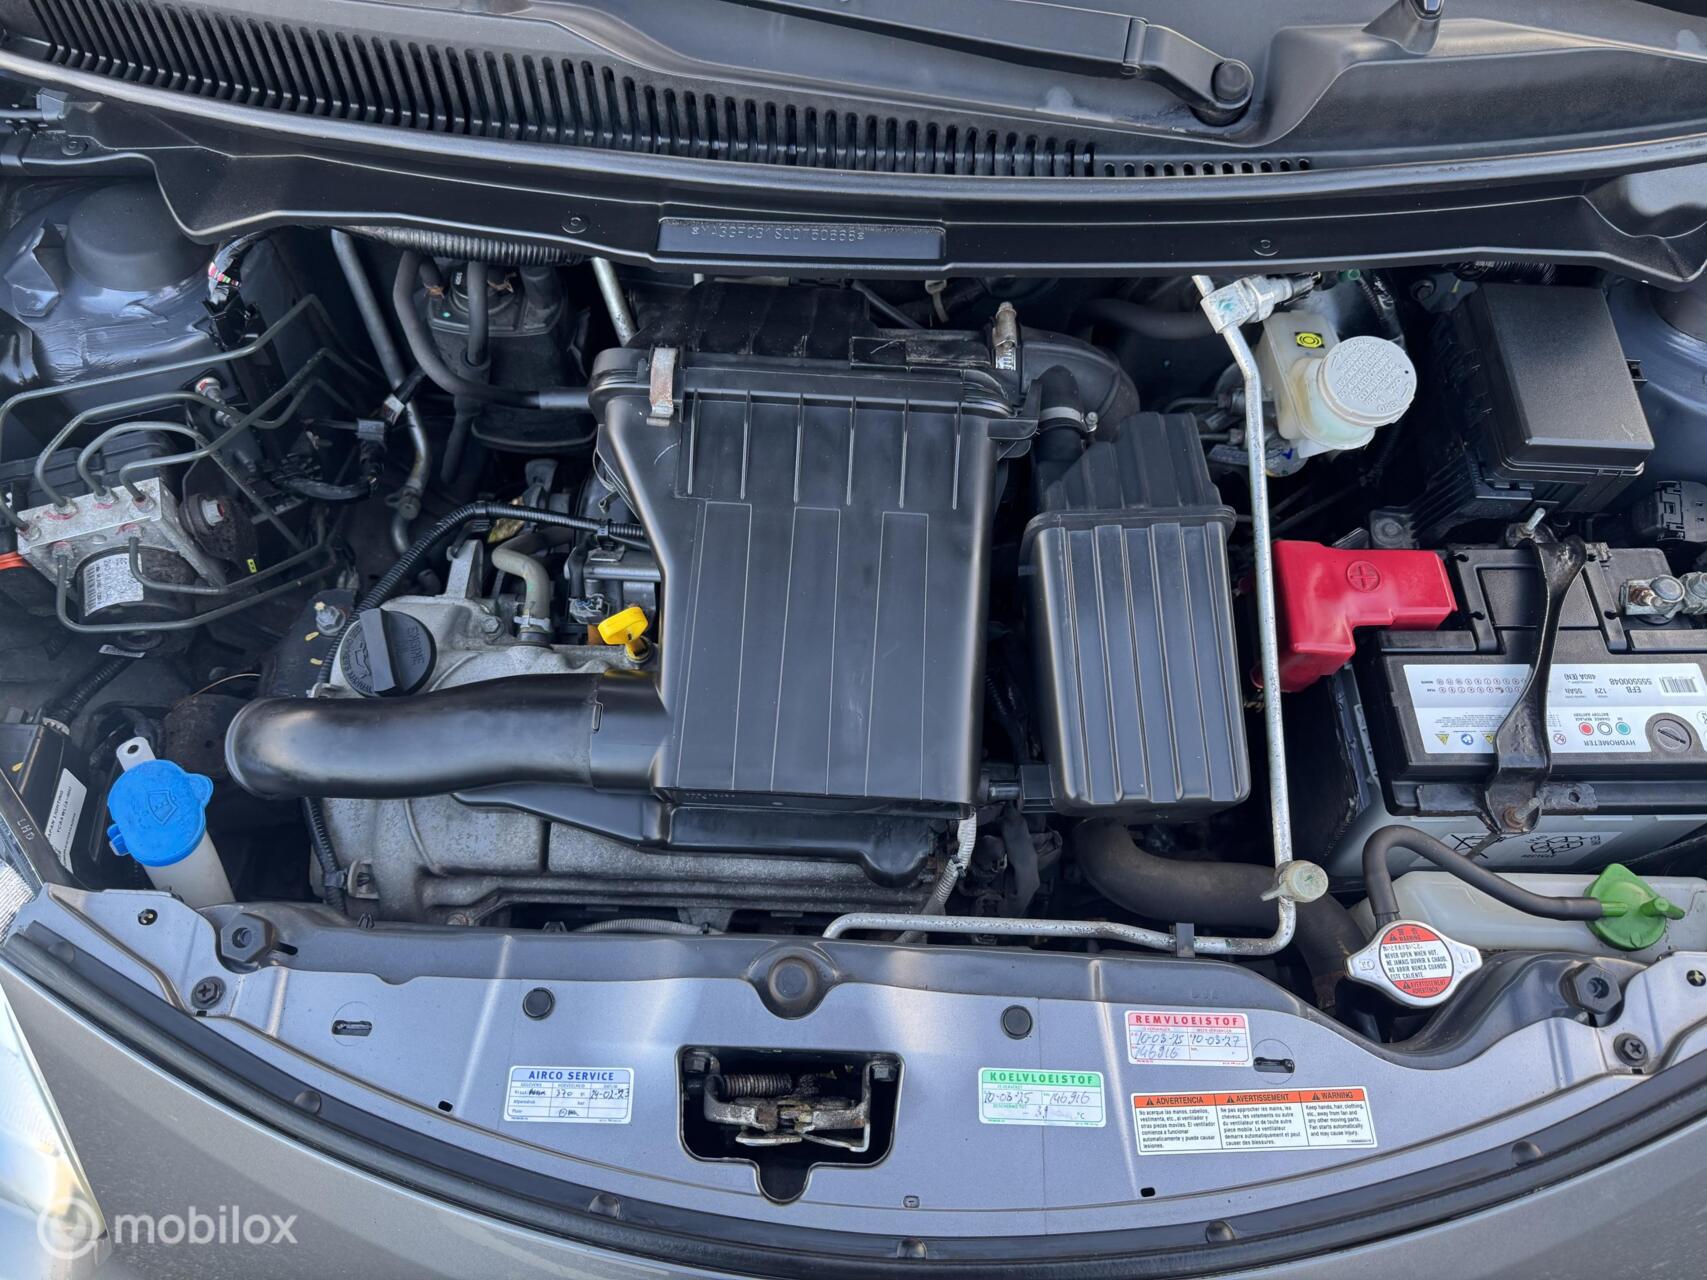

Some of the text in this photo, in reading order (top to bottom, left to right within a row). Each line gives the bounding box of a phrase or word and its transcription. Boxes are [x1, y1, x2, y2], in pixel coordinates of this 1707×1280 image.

[1136, 1015, 1239, 1025] REMVLOEISTOF
[528, 1071, 614, 1080] AIRCO SERVICE
[990, 1072, 1094, 1084] KOELVLOEISTOF
[1156, 1096, 1204, 1105] ADVERTENCIA
